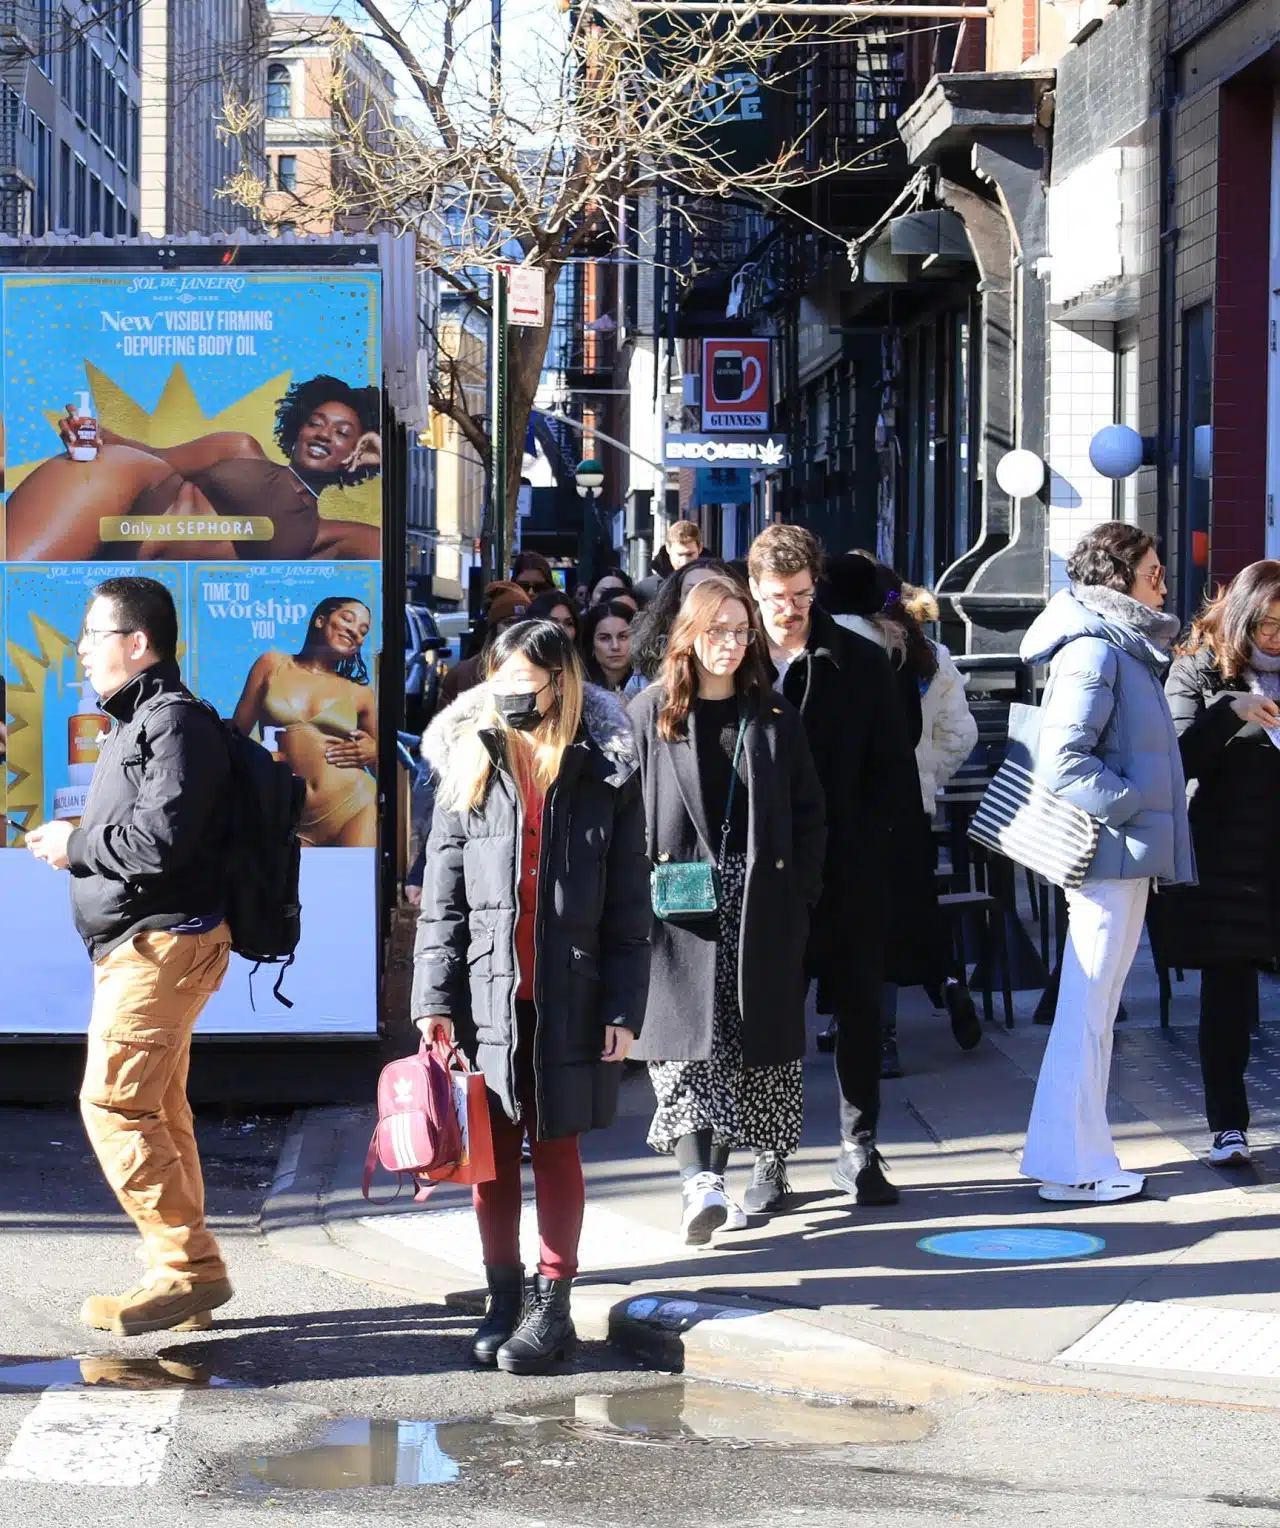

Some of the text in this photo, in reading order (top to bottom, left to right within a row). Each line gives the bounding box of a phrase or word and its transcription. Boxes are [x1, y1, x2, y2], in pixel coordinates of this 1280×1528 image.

[127, 277, 246, 293] SOL DE JANEIRO
[99, 310, 273, 331] New VISIBLY FIRMING
[198, 335, 233, 356] BODY
[236, 335, 257, 356] OIL
[711, 415, 762, 426] GUINNESS
[120, 521, 254, 538] Only at SEPHORA
[202, 582, 249, 601] TIME TO
[207, 599, 307, 624] worship
[251, 620, 276, 639] YOU
